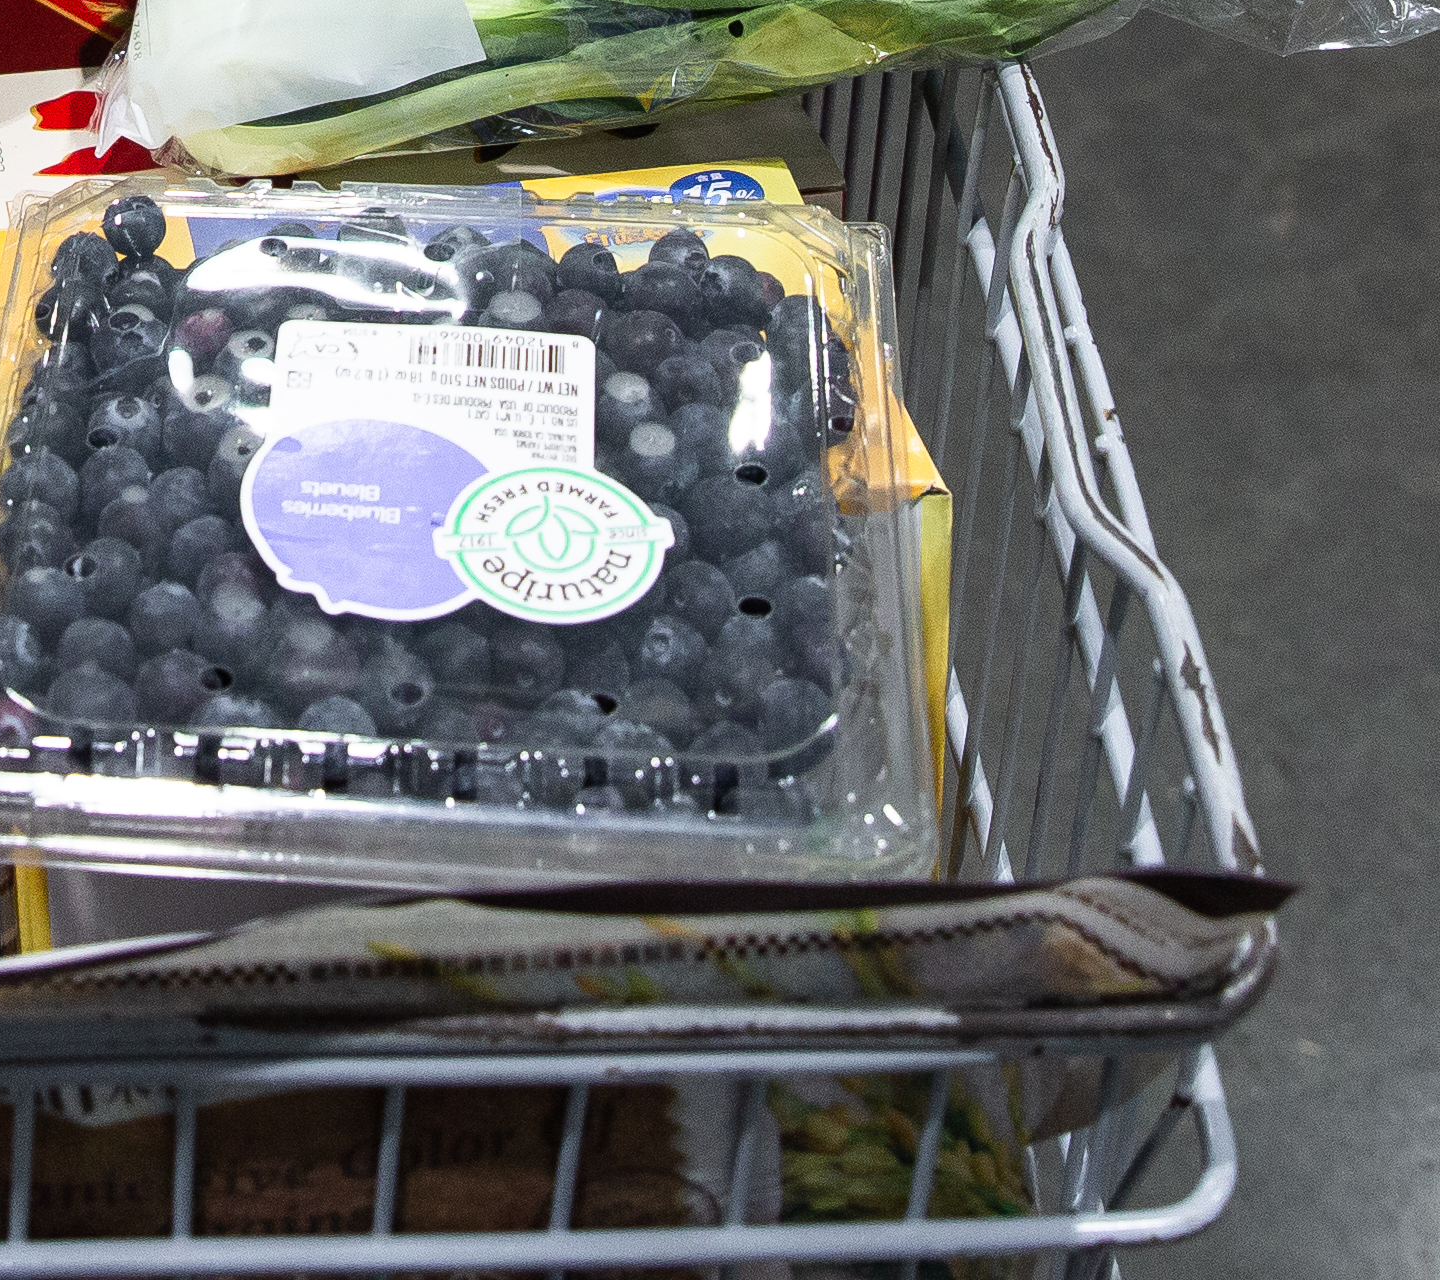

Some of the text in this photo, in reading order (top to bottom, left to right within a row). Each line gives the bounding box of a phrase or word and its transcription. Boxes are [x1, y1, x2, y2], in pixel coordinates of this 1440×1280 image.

[440, 373, 461, 385] 510
[466, 375, 486, 388] NET
[491, 376, 524, 392] POIDS
[537, 381, 553, 394] WT
[558, 383, 578, 396] NET
[433, 394, 577, 416] PRODUCT OF USA PRODUIT DES
[300, 480, 380, 501] Bleuets
[476, 480, 619, 524] FARMED FRESH
[281, 499, 401, 524] Blueberries
[459, 534, 493, 548] 1917
[608, 527, 649, 542] since
[482, 549, 632, 603] naturipe
